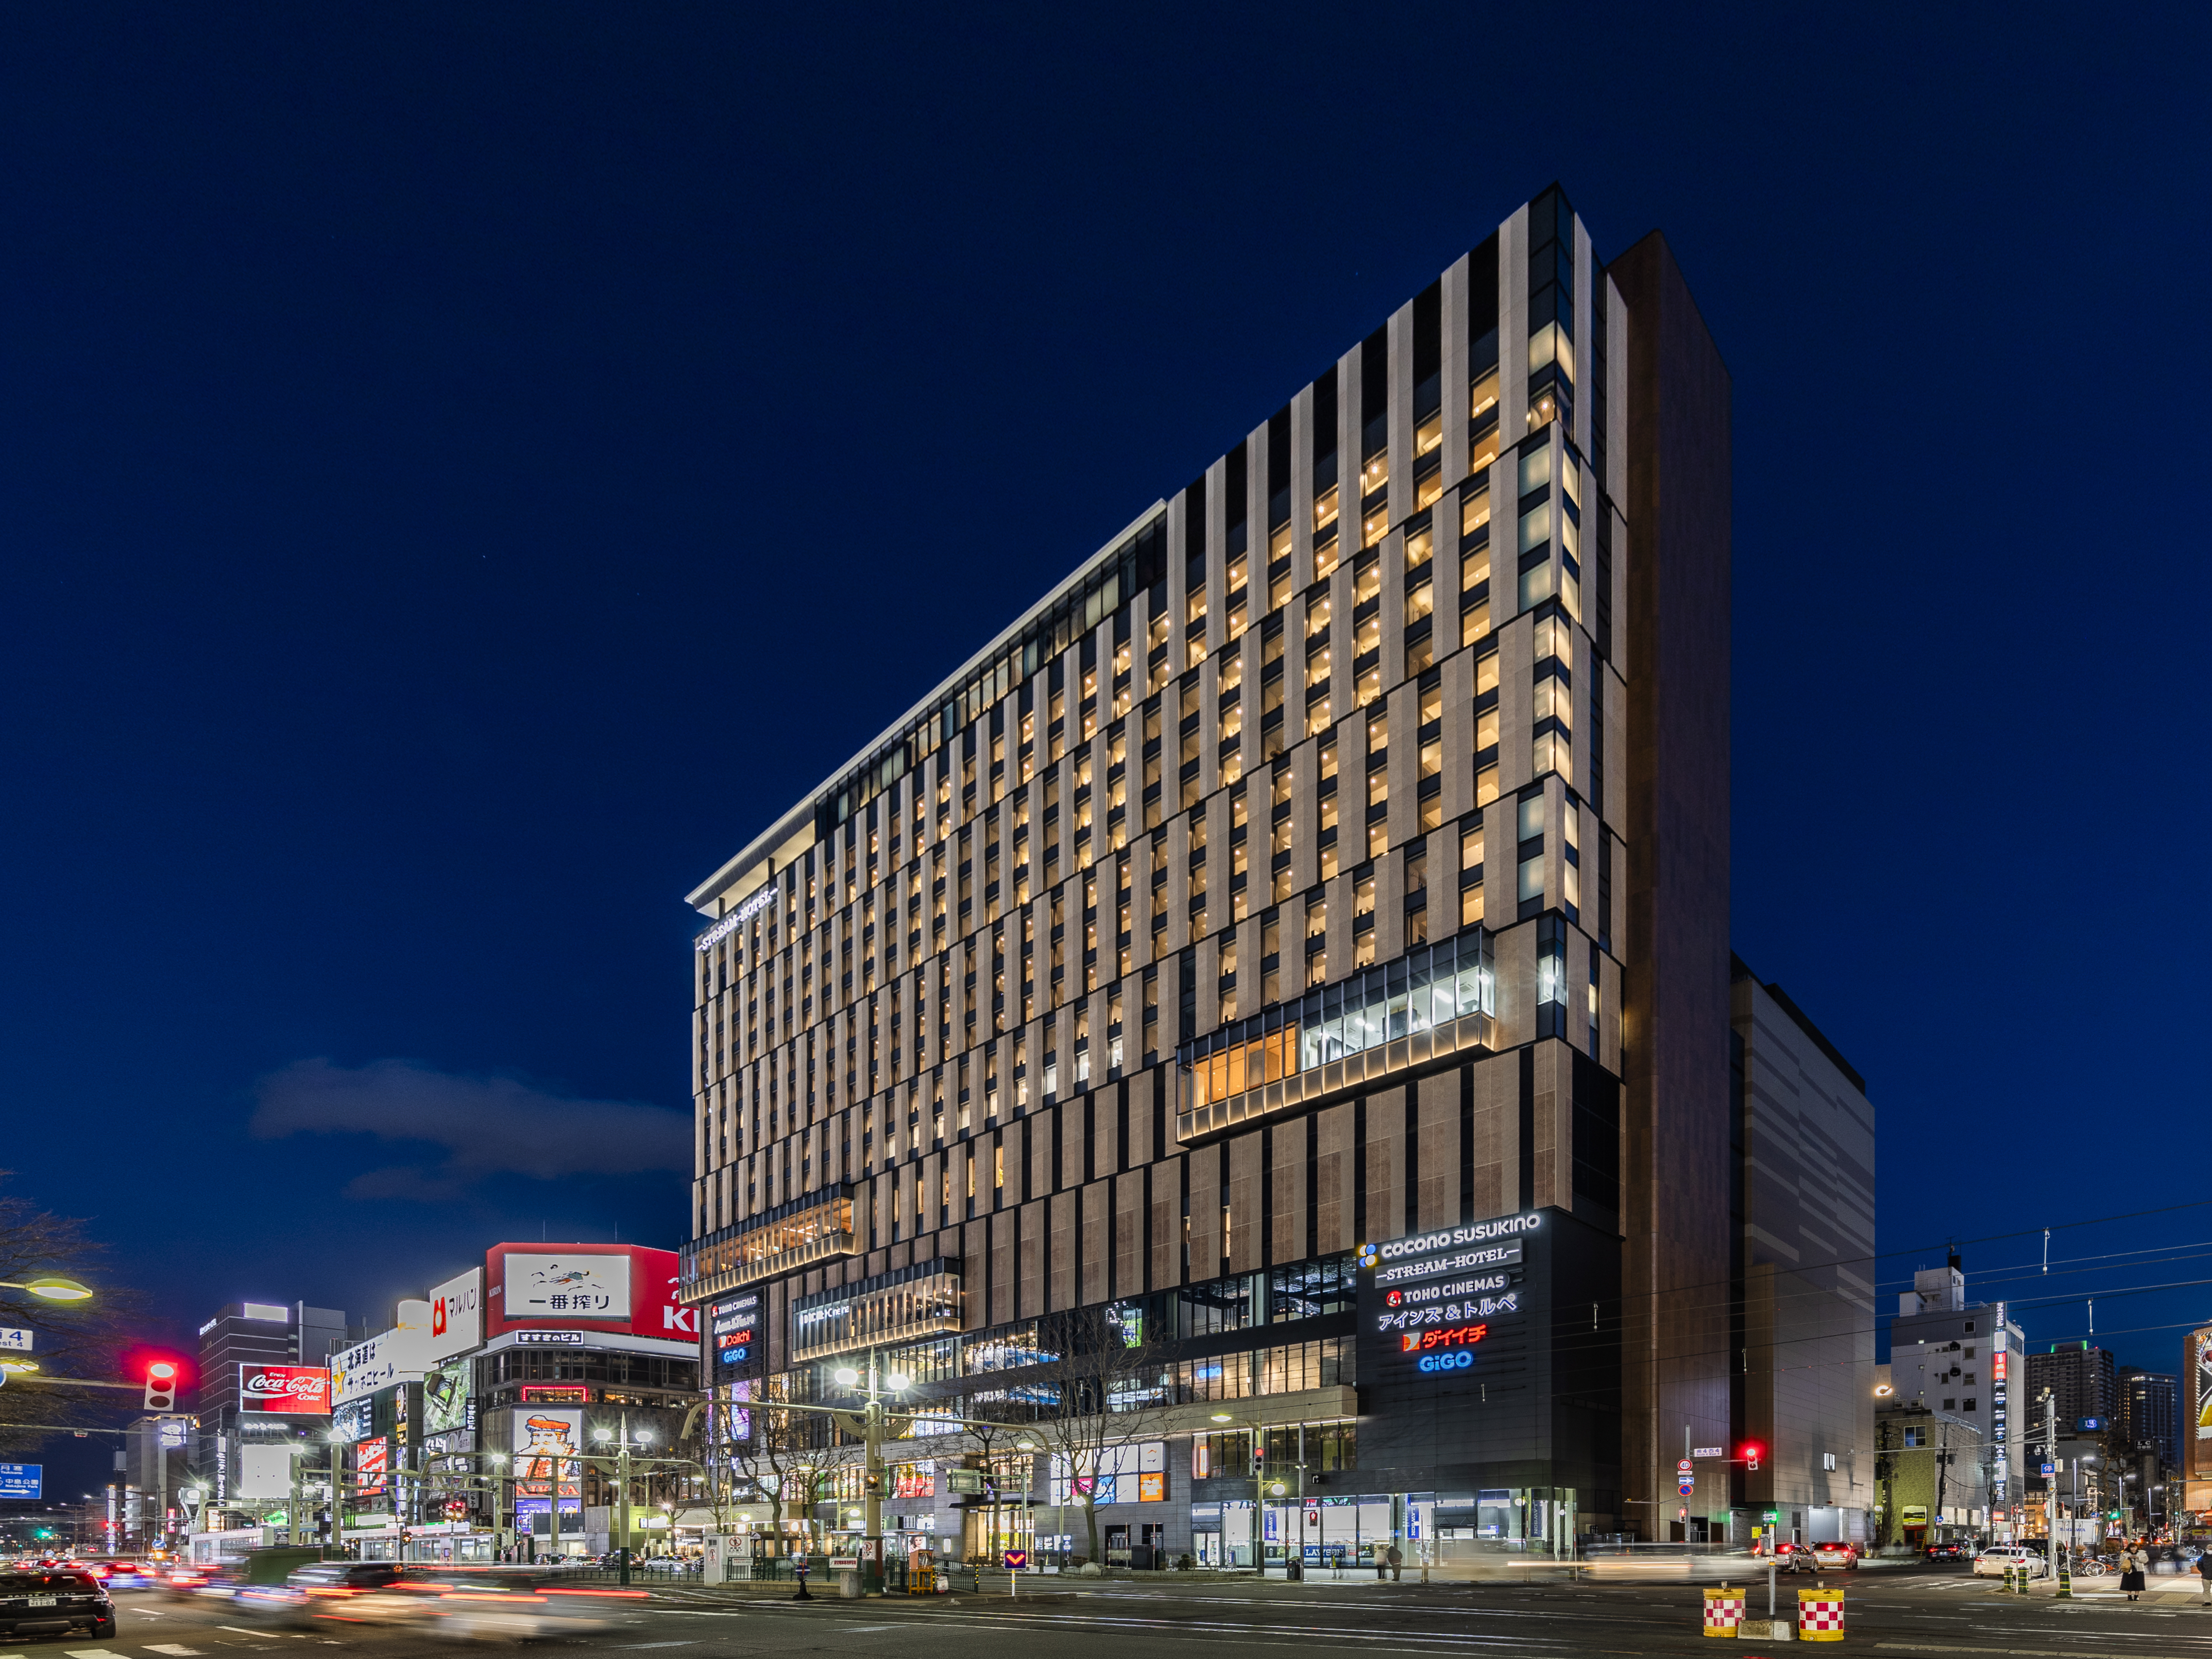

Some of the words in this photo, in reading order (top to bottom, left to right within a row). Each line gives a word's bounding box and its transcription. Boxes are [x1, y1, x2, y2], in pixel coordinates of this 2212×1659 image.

[1381, 1233, 1450, 1258] COCONO
[1454, 1214, 1540, 1244] SUSUKINO
[1387, 1259, 1447, 1281] STREAM
[1455, 1247, 1507, 1268] HOTEL
[1405, 1287, 1440, 1304] TOHO
[1443, 1275, 1504, 1297] CINEMAS
[449, 1287, 477, 1318] マルハン
[529, 1294, 610, 1310] 一番搾り
[520, 1333, 580, 1342] すすきのビル
[727, 1330, 750, 1346] Daiichi
[1423, 1324, 1487, 1348] ダイイチ
[348, 1342, 375, 1371] 北海道は
[724, 1348, 746, 1363] GiGO
[1420, 1351, 1474, 1372] GiGO
[248, 1374, 327, 1393] Coca-Cola
[348, 1362, 394, 1394] サッポロビール
